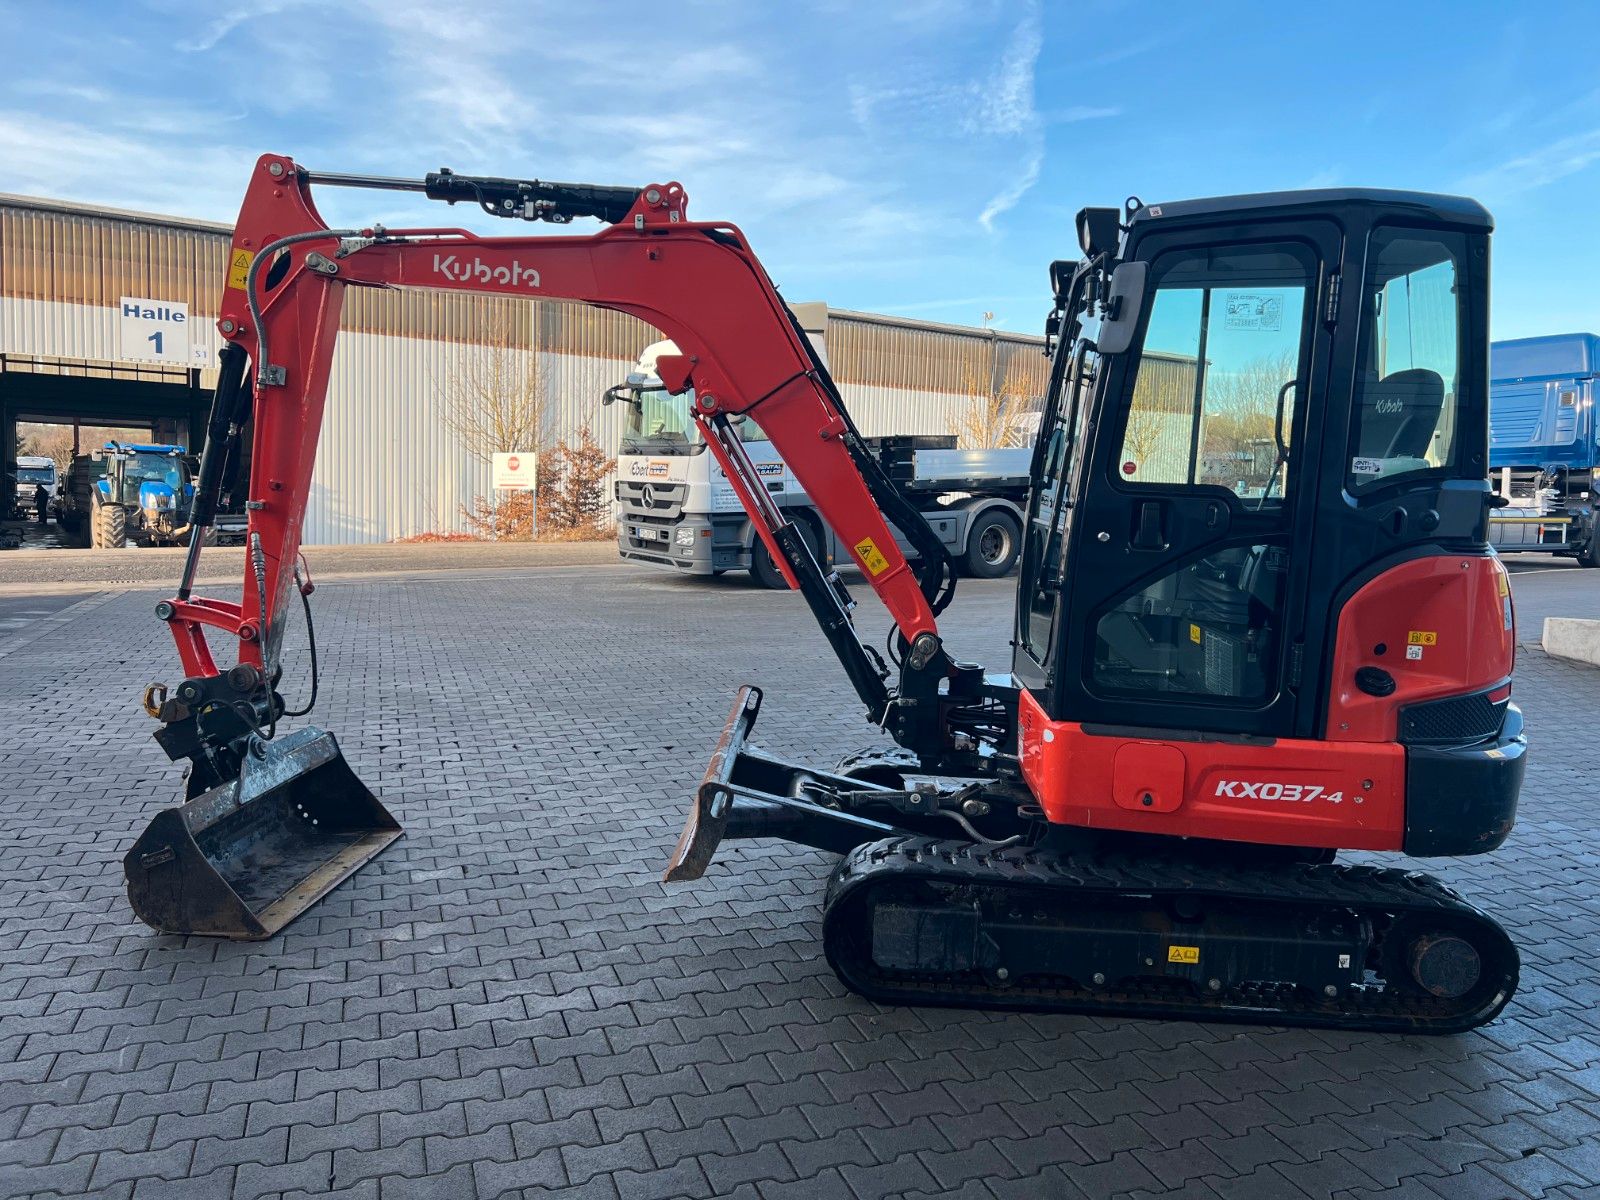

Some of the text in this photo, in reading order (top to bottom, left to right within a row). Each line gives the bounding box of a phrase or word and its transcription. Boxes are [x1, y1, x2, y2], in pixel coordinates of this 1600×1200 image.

[433, 254, 540, 288] Kubota
[123, 303, 186, 322] Halle
[148, 331, 163, 354] 1
[1214, 780, 1344, 803] KX037-4
